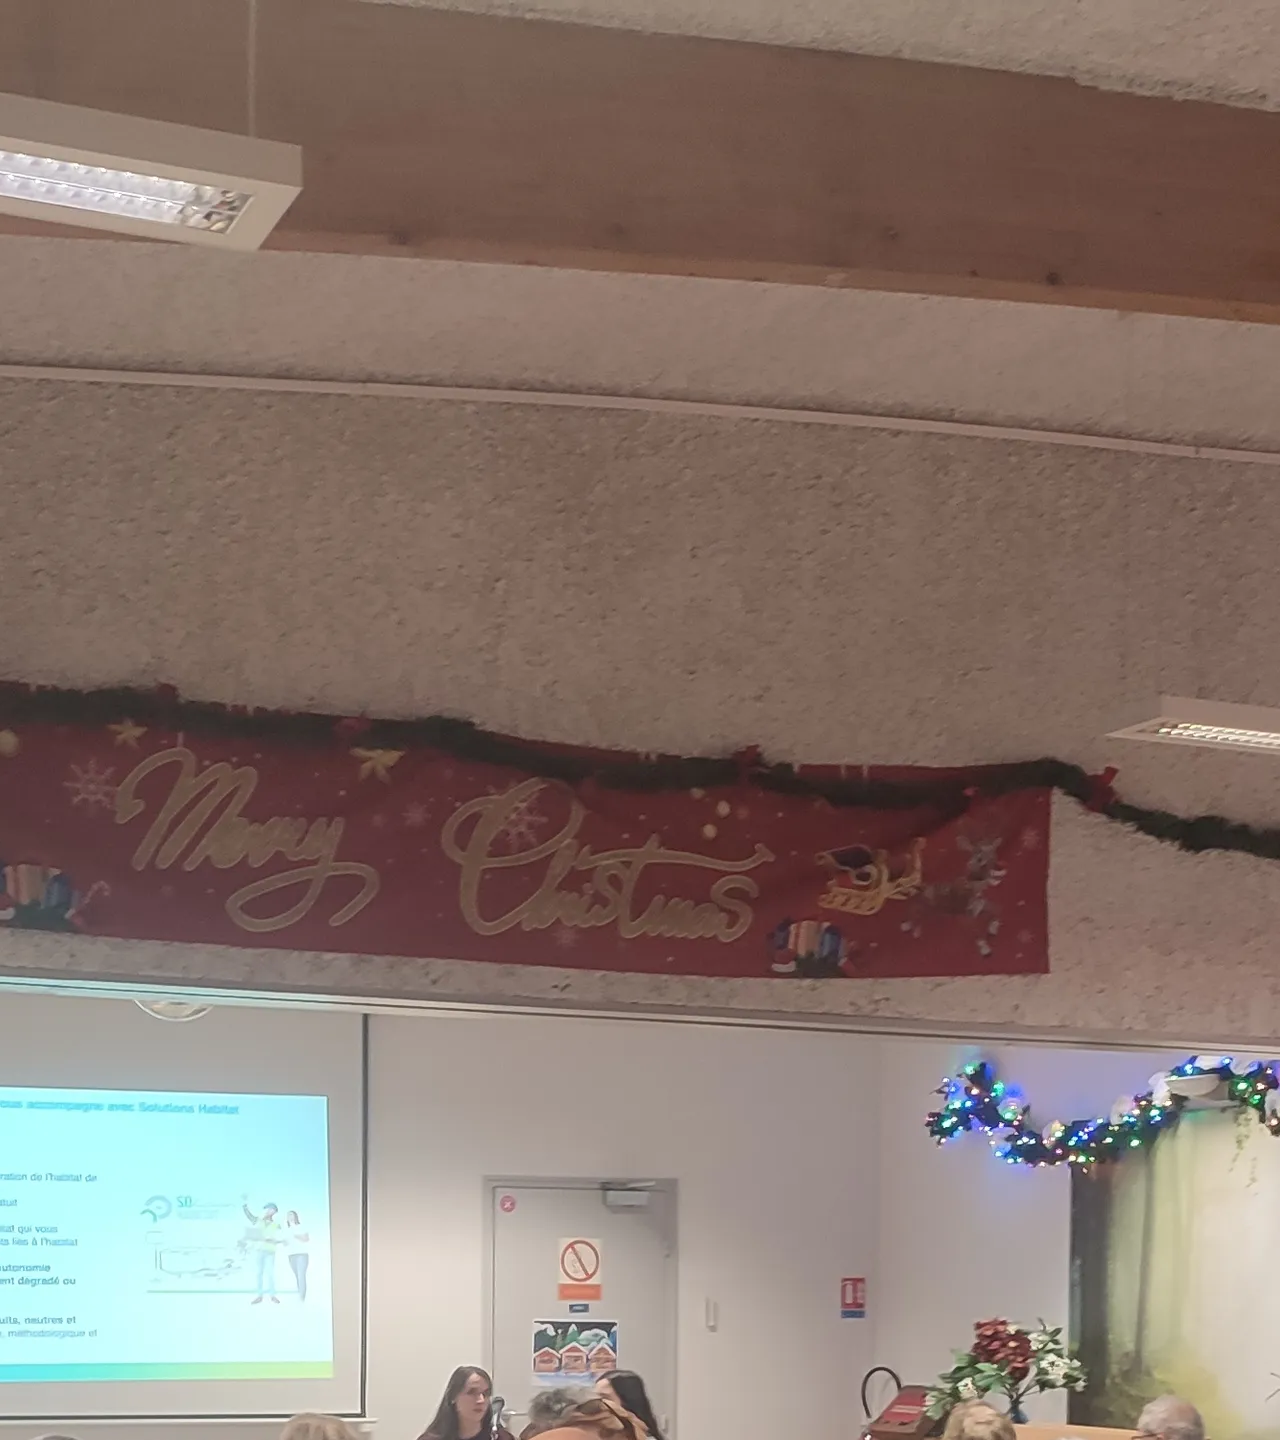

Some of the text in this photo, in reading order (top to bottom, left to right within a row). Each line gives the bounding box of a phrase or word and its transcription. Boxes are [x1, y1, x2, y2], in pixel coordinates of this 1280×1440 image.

[119, 747, 776, 943] Merry Christmas
[30, 1172, 43, 1182] de
[85, 1173, 98, 1183] de
[17, 1223, 32, 1234] qui
[17, 1276, 60, 1287] dégradé
[62, 1277, 76, 1285] ou
[24, 1316, 64, 1325] neutres
[66, 1315, 77, 1325] et
